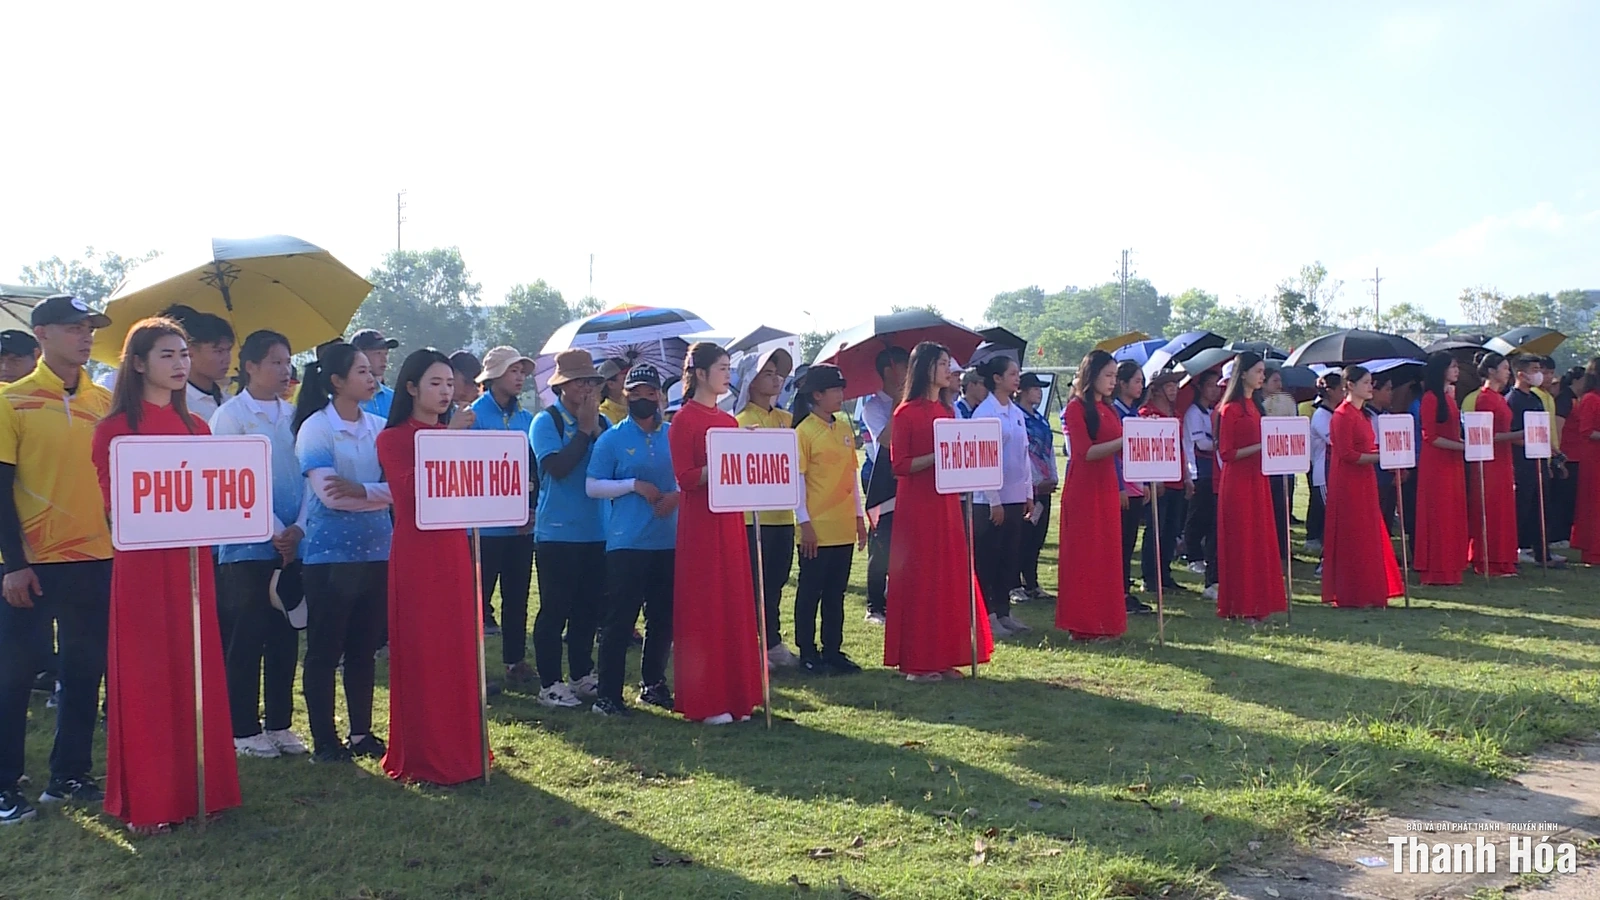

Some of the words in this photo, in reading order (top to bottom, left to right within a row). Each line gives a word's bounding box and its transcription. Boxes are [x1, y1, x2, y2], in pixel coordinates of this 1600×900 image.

[940, 441, 951, 470] TP.
[964, 434, 977, 468] CHÍ
[979, 440, 999, 468] MINH
[1128, 432, 1151, 462] THÀNH
[1151, 429, 1163, 462] PHỐ
[1290, 434, 1306, 456] NINH
[425, 460, 484, 498] THANH
[489, 452, 521, 497] HÓA
[720, 453, 742, 485] AN
[746, 453, 790, 485] GIANG
[132, 461, 193, 514] PHÚ
[202, 468, 256, 518] THỌ
